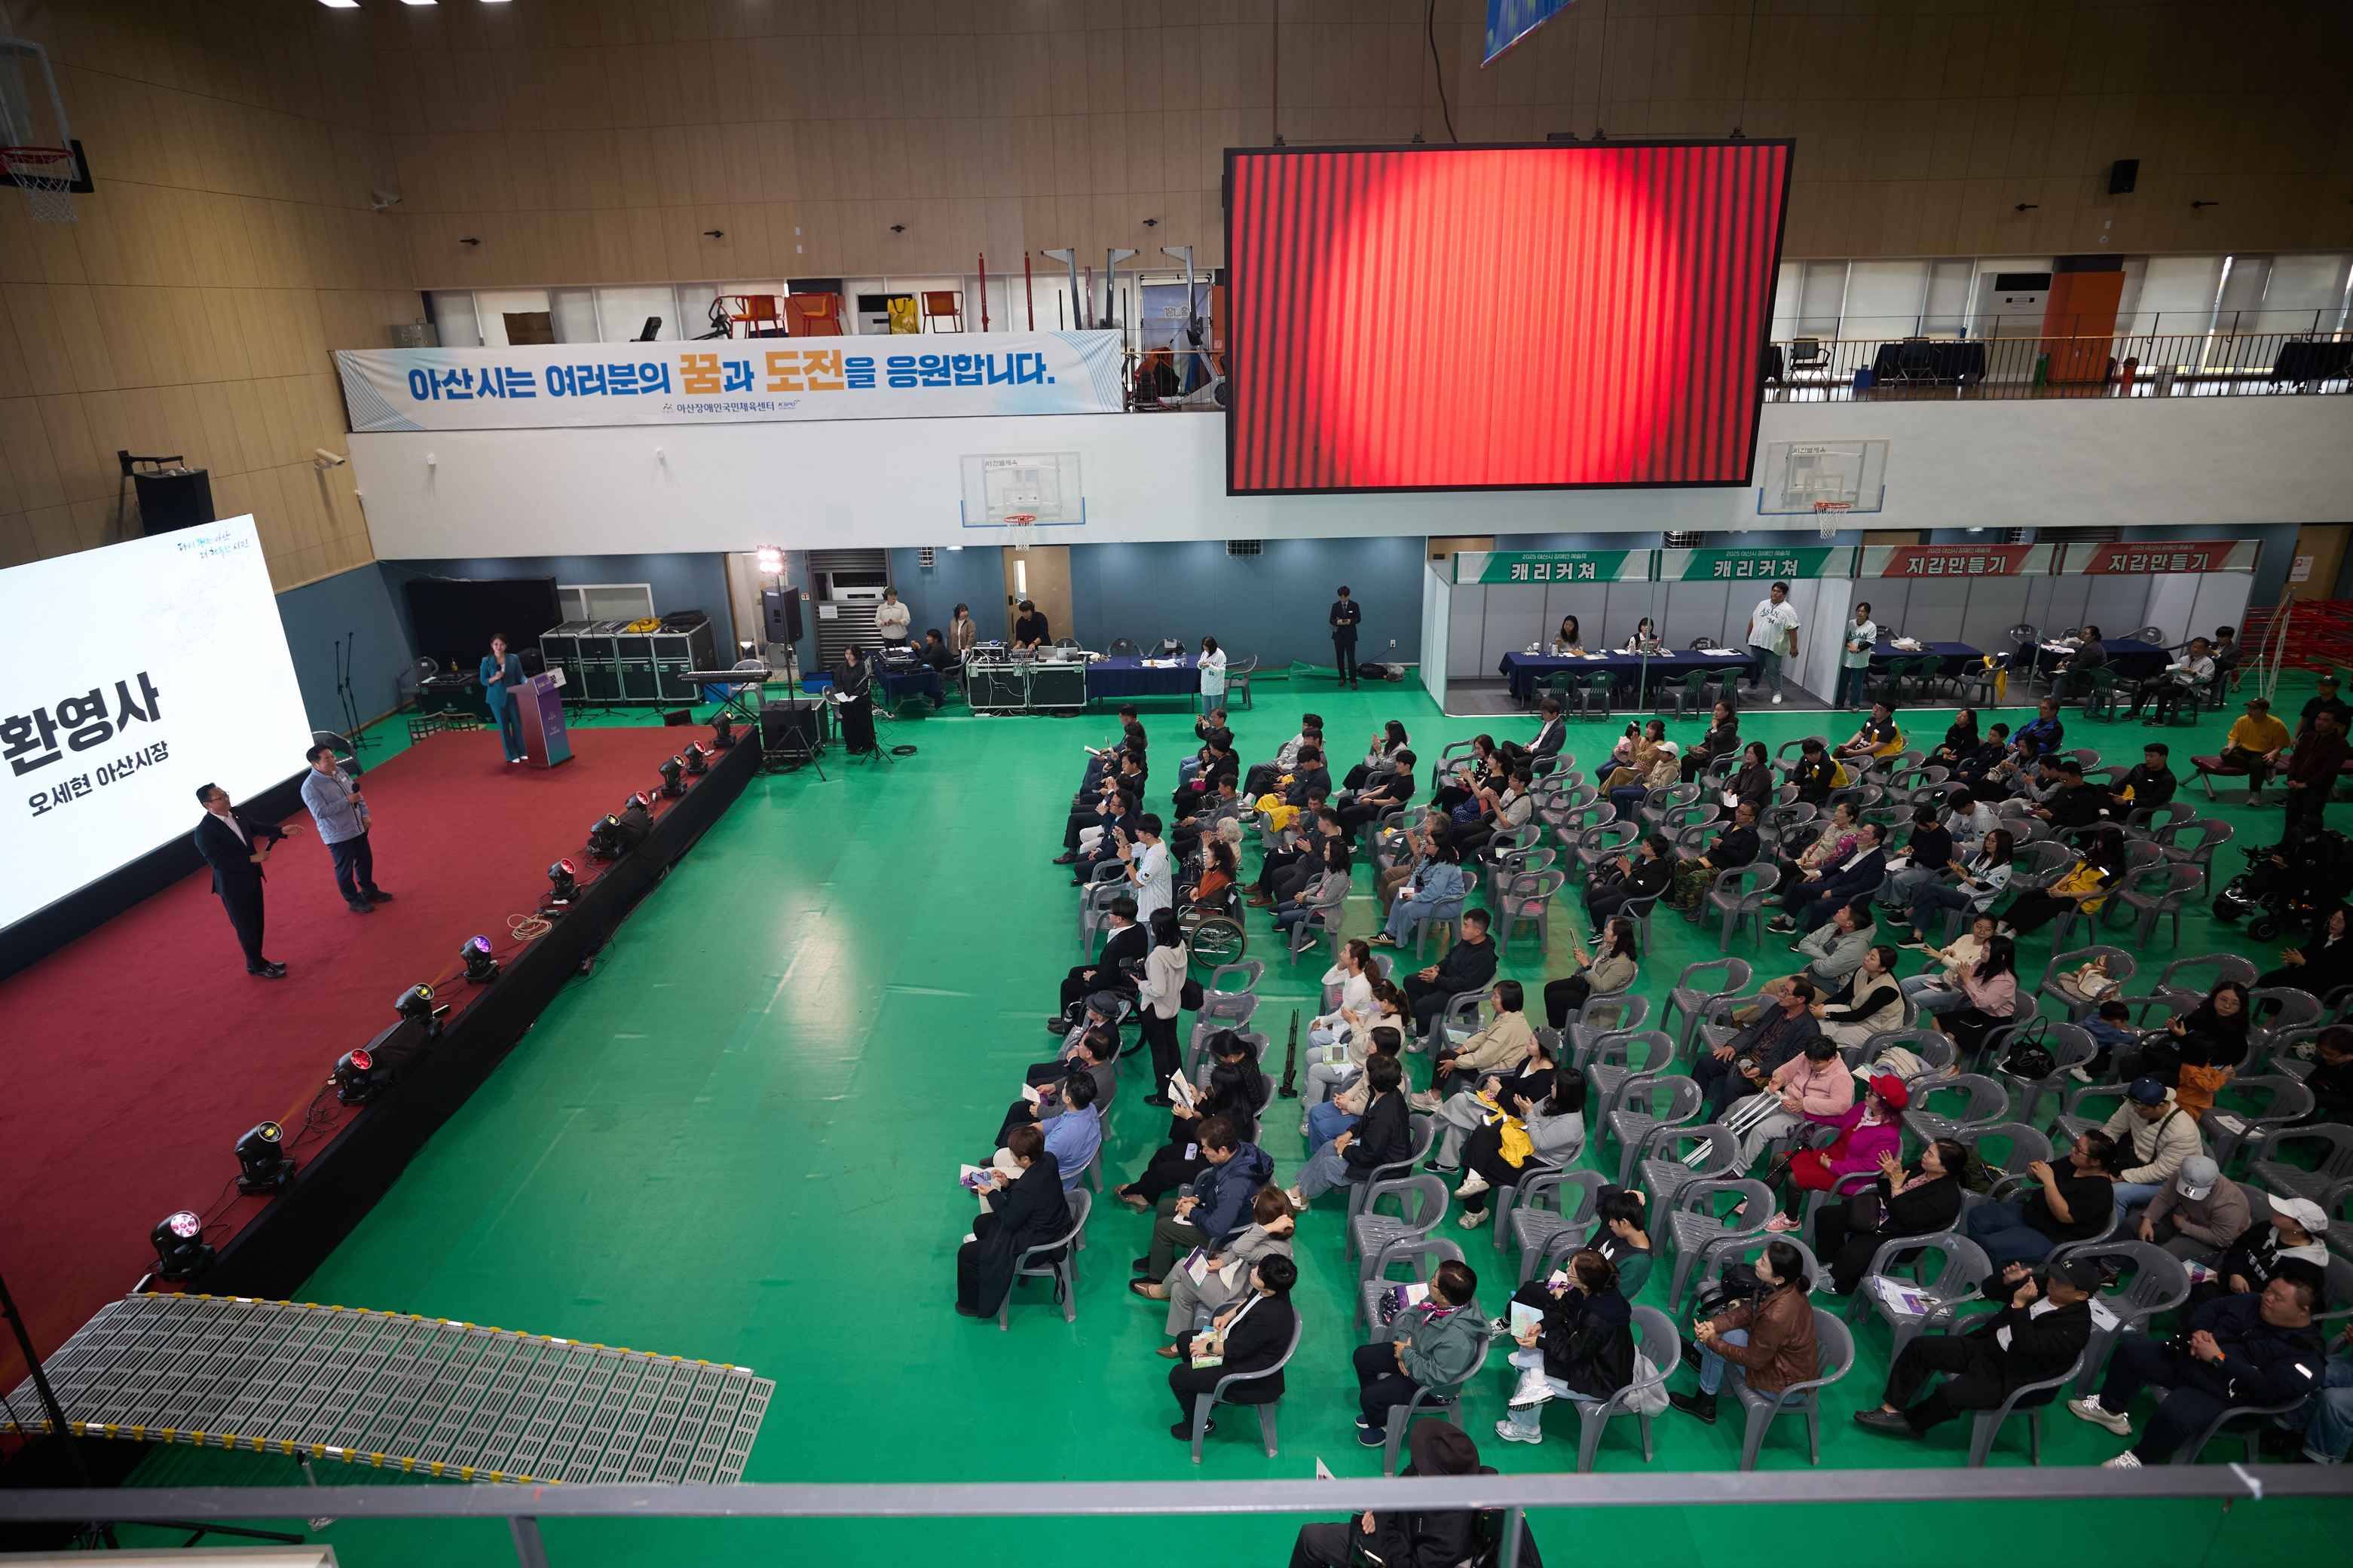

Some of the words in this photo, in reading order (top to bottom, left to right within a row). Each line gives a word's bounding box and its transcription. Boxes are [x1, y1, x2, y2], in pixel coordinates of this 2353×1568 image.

[408, 366, 537, 401] 아산시는
[546, 362, 671, 397] 여러분의
[679, 353, 754, 395] 꿈과
[765, 349, 877, 393] 도전을
[886, 352, 1055, 389] 응원합니다.
[677, 401, 775, 414] 아산장애인국민체육센터
[1510, 562, 1596, 580] 캐리커쳐
[1713, 559, 1798, 577] 캐리커쳐
[1906, 555, 2007, 574] 지갑만들기
[2108, 553, 2209, 571] 지갑만들기
[0, 671, 161, 777] 환영사
[28, 773, 93, 818] 오세현
[96, 740, 170, 787] 아산시장
